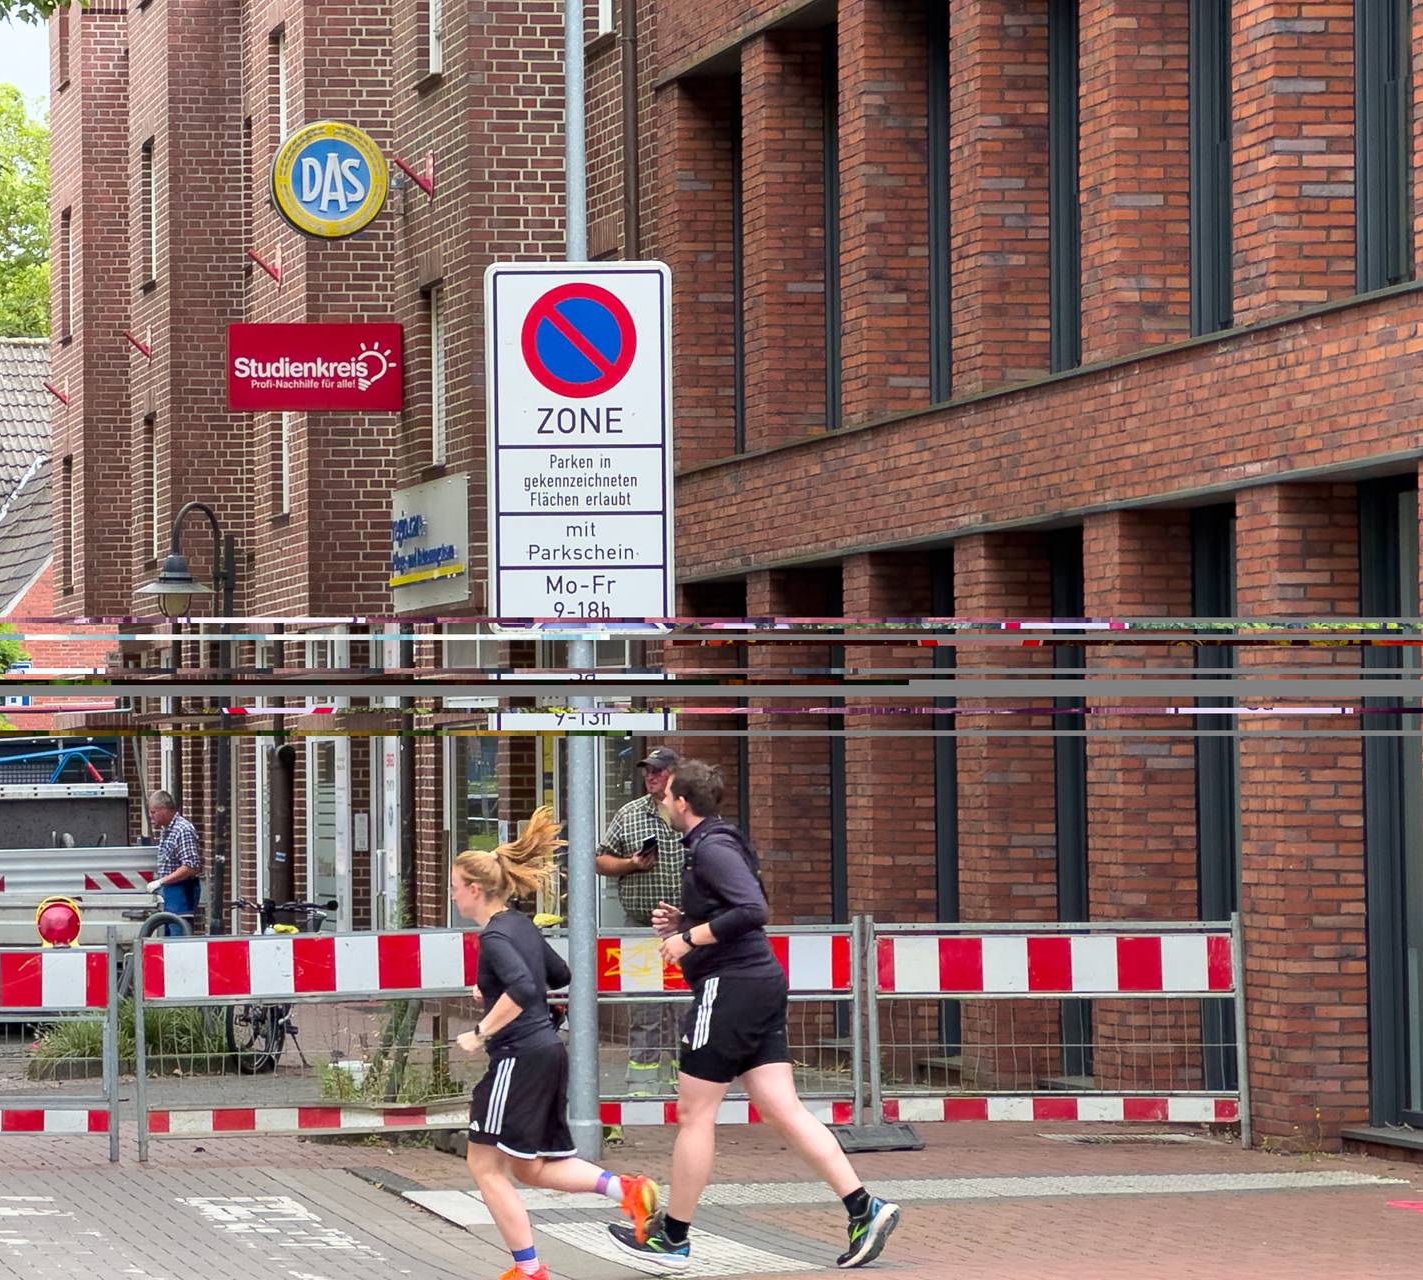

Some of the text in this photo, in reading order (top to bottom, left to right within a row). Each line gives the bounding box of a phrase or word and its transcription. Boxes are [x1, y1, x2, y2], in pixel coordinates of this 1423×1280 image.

[301, 152, 365, 212] DAS
[234, 357, 368, 378] Studienkreis
[251, 379, 356, 389] Profi-Nachhilfe für alle!
[537, 407, 623, 434] ZONE
[550, 453, 611, 469] Parken in
[524, 473, 638, 492] gekennzeichneten
[530, 491, 631, 507] Flächen erlaubt
[566, 521, 596, 537] mit
[529, 544, 634, 560] Parkschein
[546, 575, 616, 594] Mo-Fr
[553, 601, 610, 618] 9-18h
